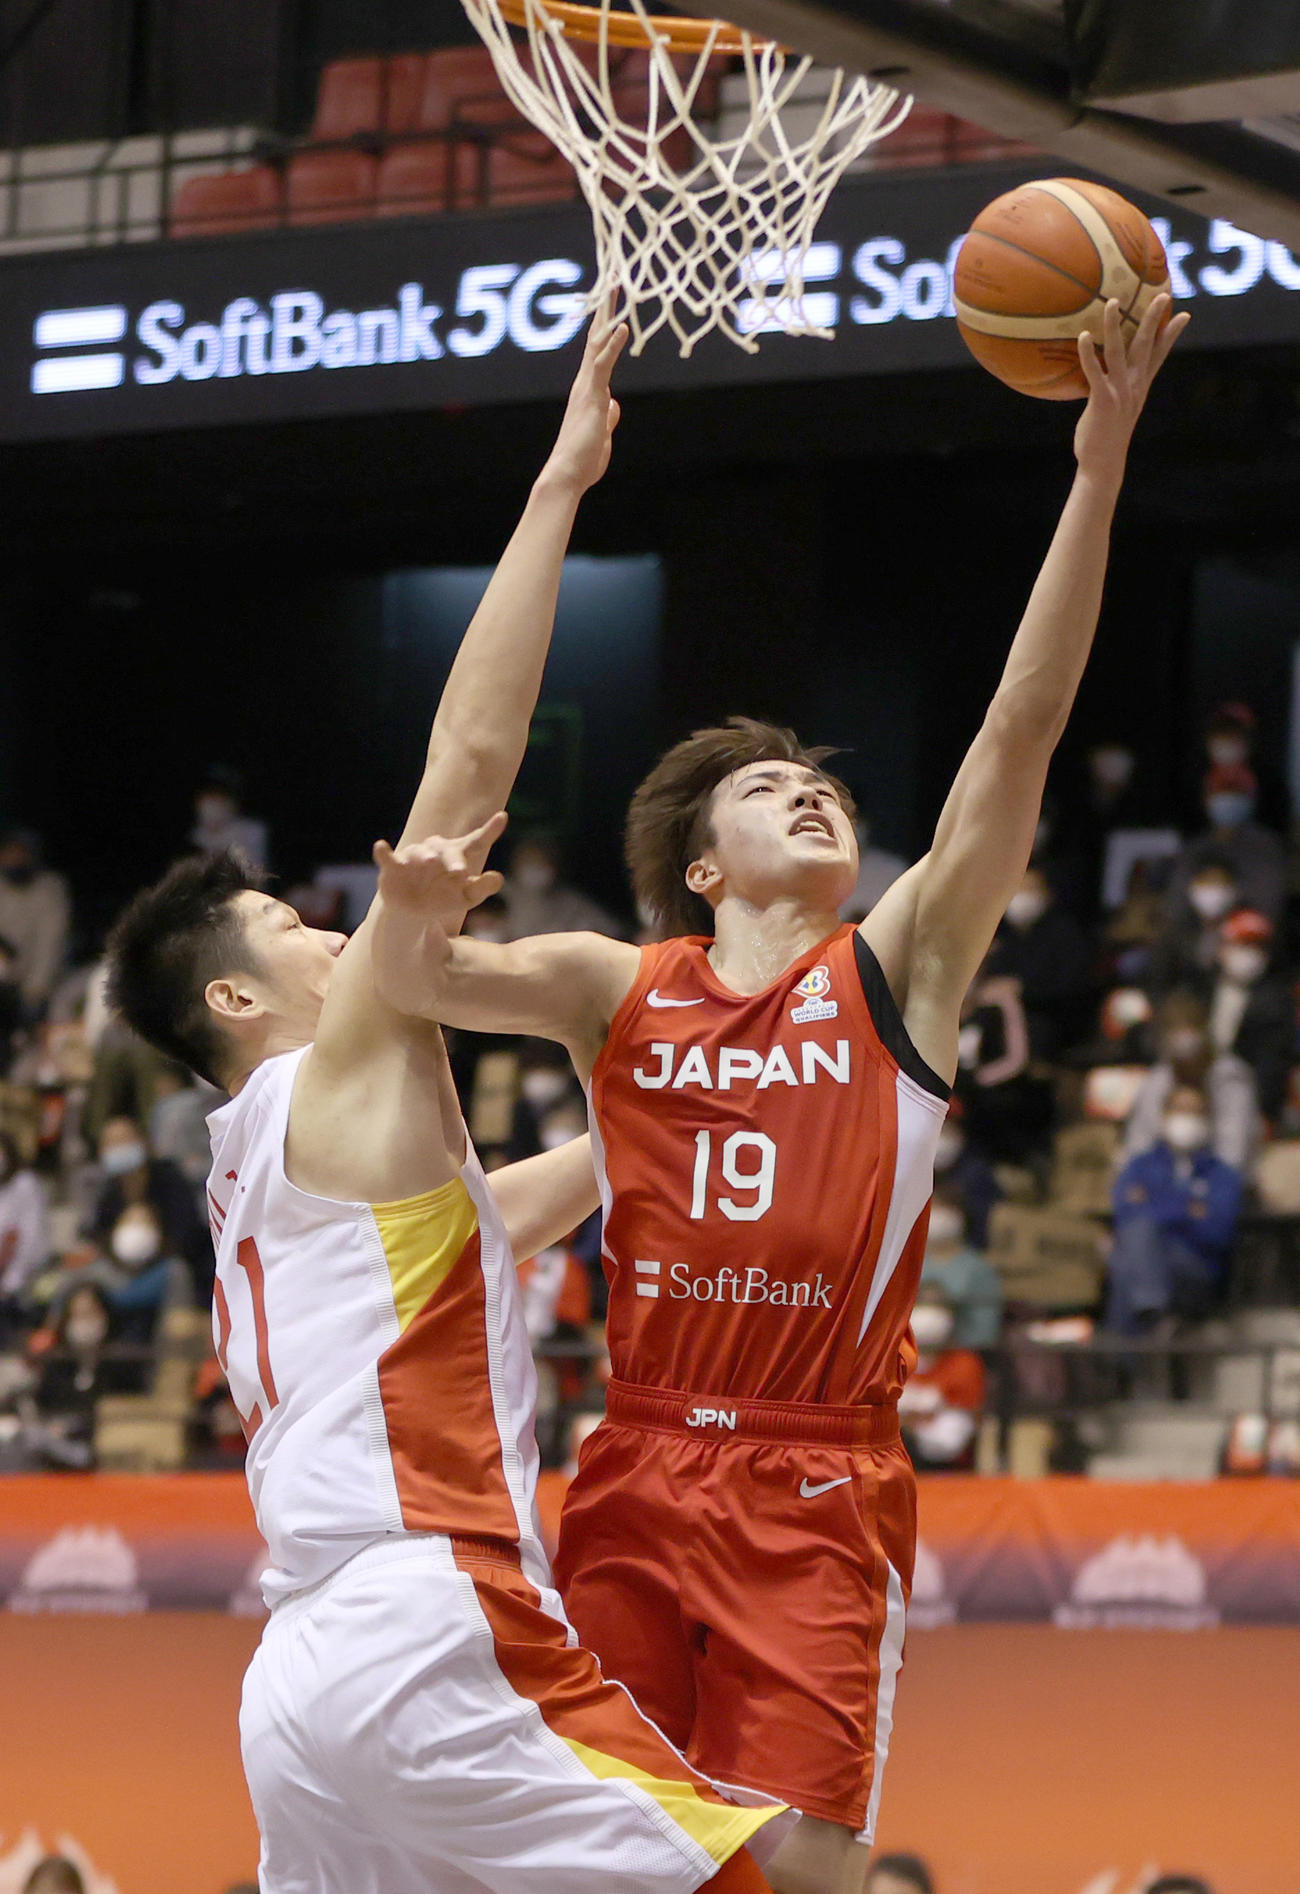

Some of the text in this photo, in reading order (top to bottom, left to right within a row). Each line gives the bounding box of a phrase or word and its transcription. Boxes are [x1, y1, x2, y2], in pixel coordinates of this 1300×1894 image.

[133, 257, 588, 385] SoftBank 5G
[793, 1008, 819, 1017] WORLD
[632, 1039, 850, 1090] JAPAN
[689, 1129, 777, 1222] 19
[668, 1262, 833, 1309] SoftBank
[685, 1407, 737, 1430] JPN
